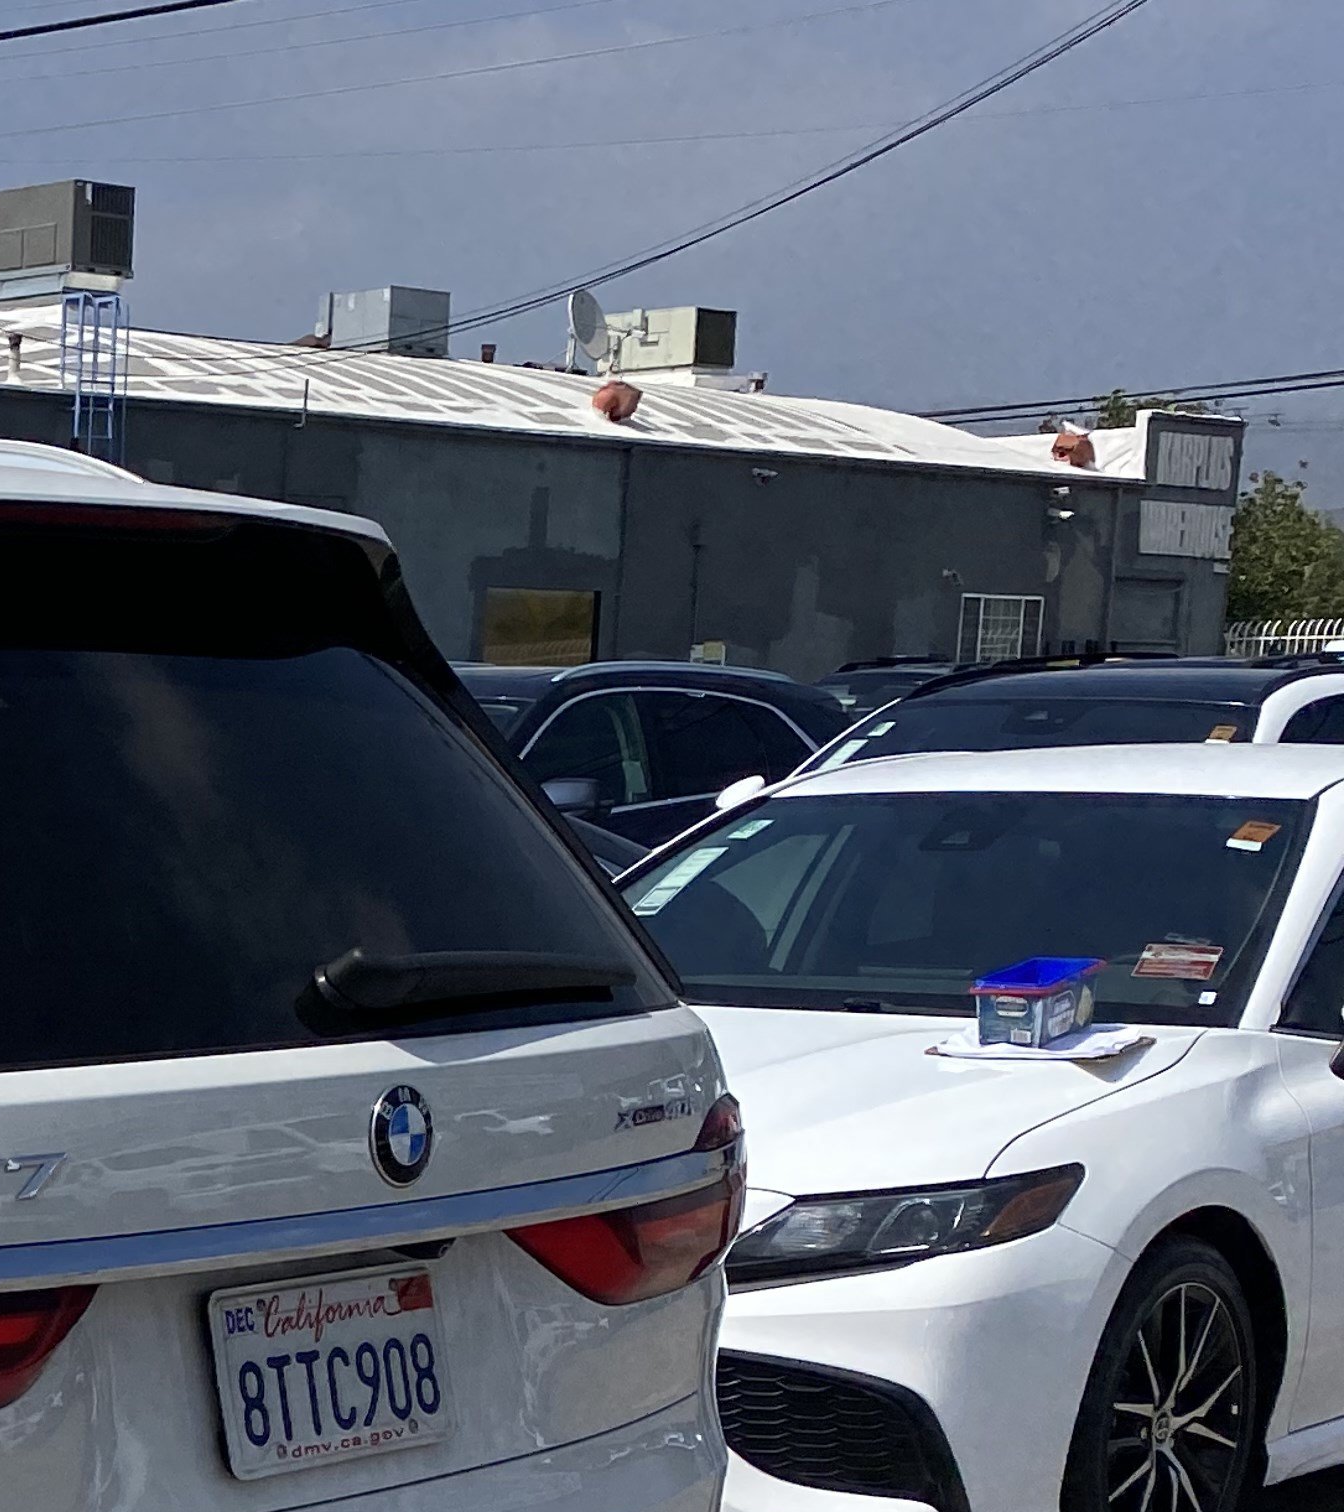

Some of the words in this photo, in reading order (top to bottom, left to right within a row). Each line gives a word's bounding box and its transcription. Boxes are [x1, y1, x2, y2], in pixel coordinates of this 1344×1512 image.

[225, 1306, 255, 1334] DEC
[264, 1288, 402, 1343] California
[239, 1333, 441, 1446] 8TTC908
[291, 1426, 405, 1459] dmv.ca.gov
